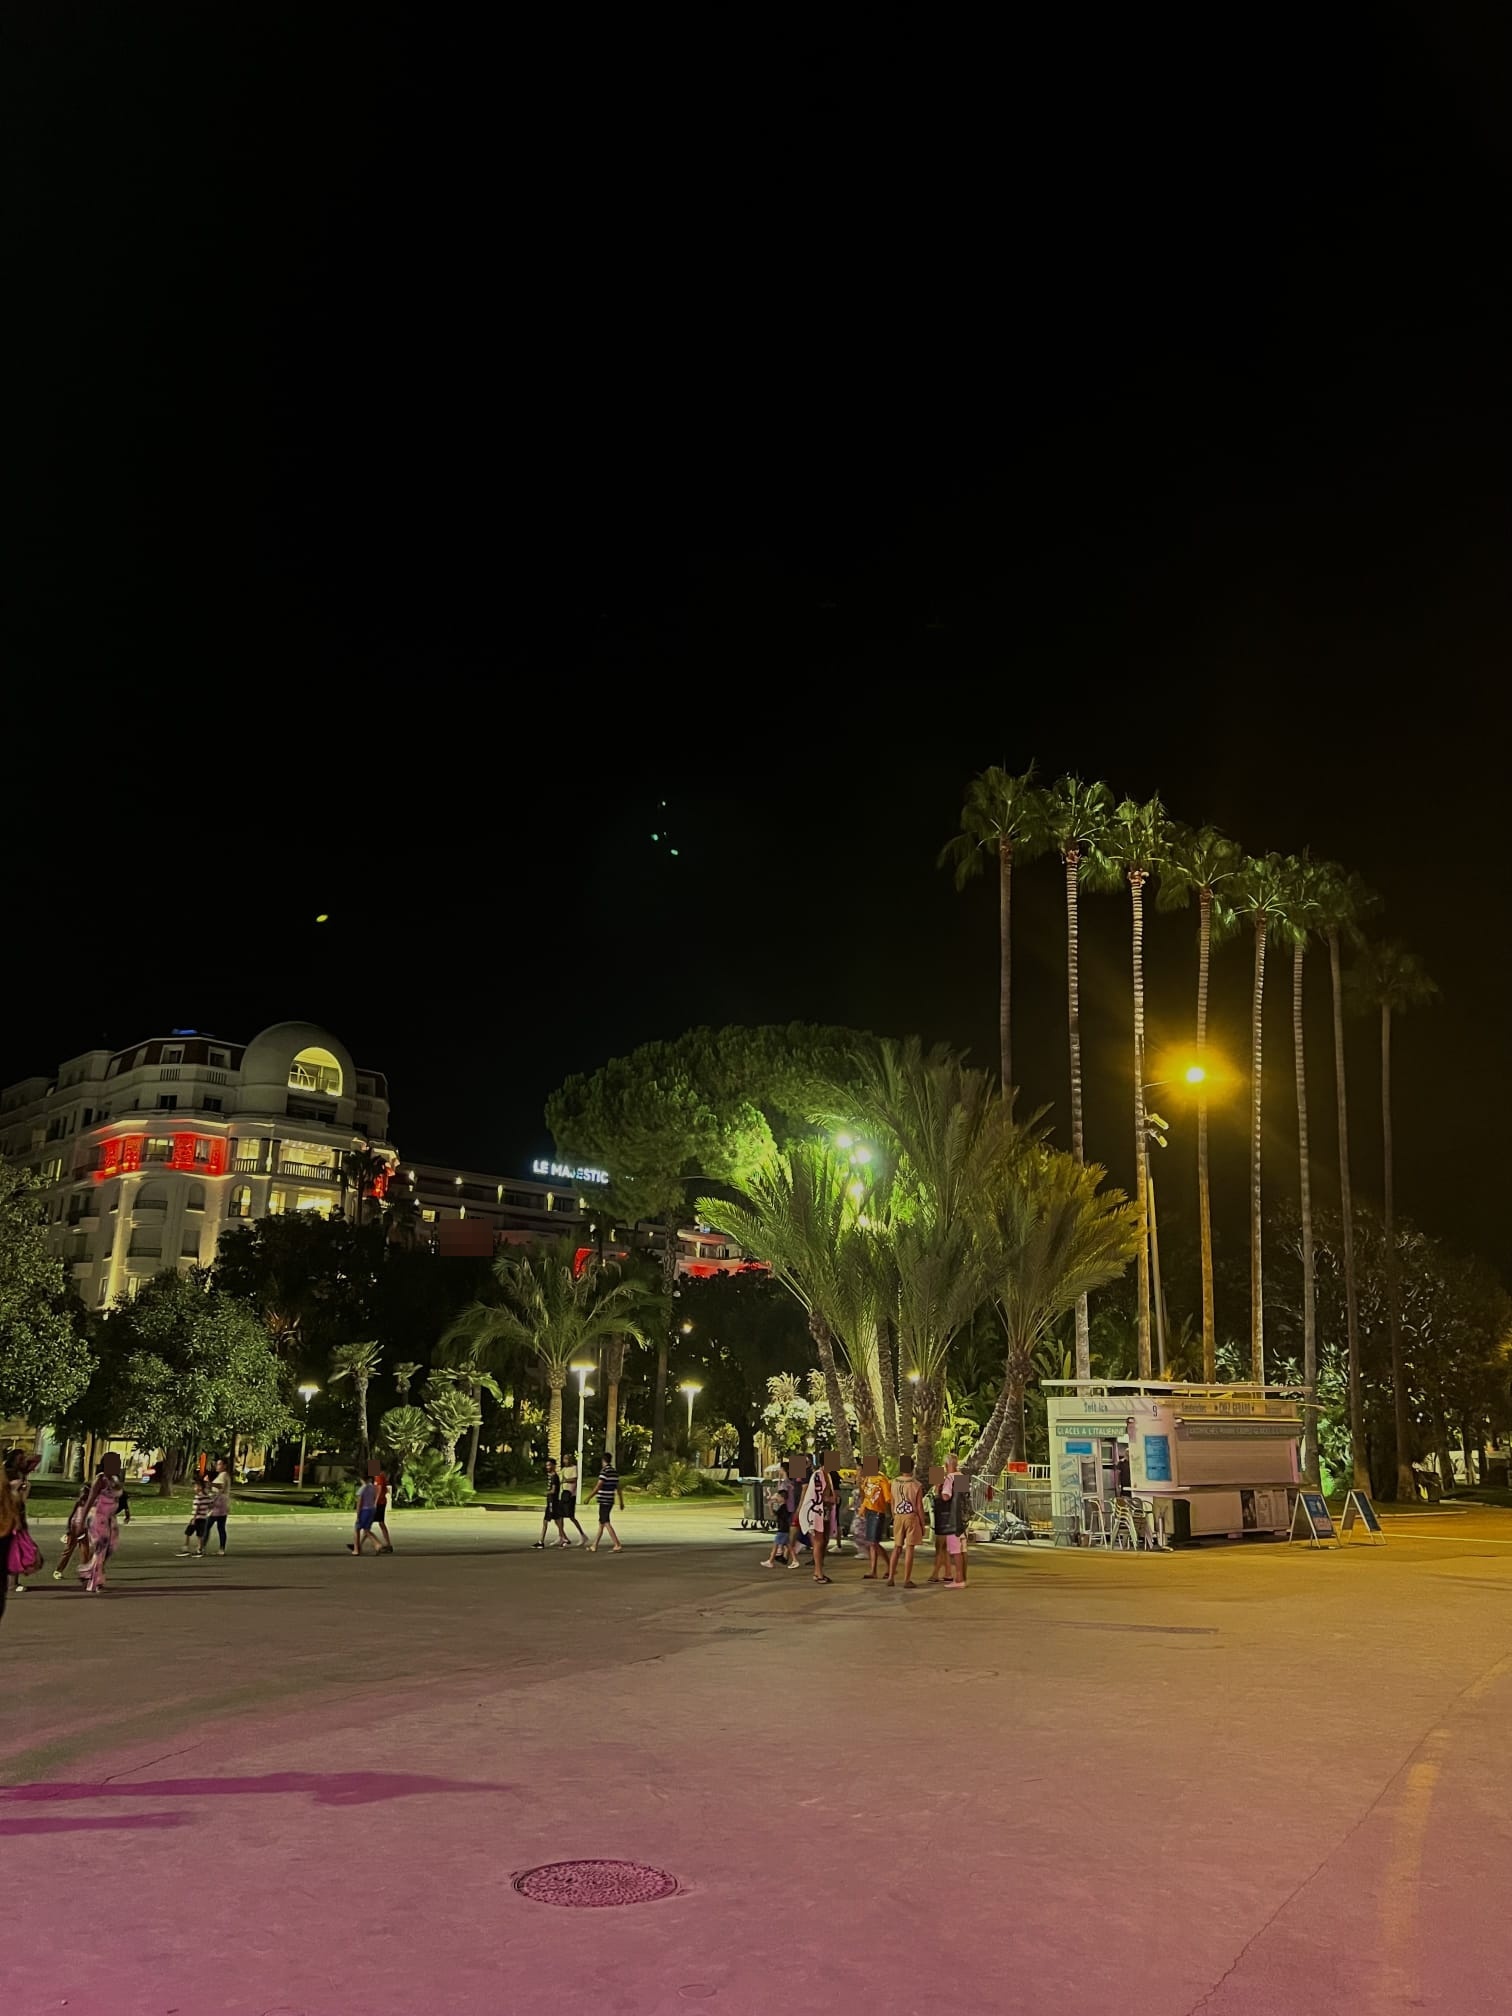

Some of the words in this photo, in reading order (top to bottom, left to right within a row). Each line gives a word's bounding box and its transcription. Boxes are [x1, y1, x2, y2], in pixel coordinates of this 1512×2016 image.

[533, 1160, 549, 1174] LE
[551, 1163, 609, 1184] MAJESTIC
[1152, 1405, 1158, 1417] 9
[1057, 1427, 1080, 1435] GLACES
